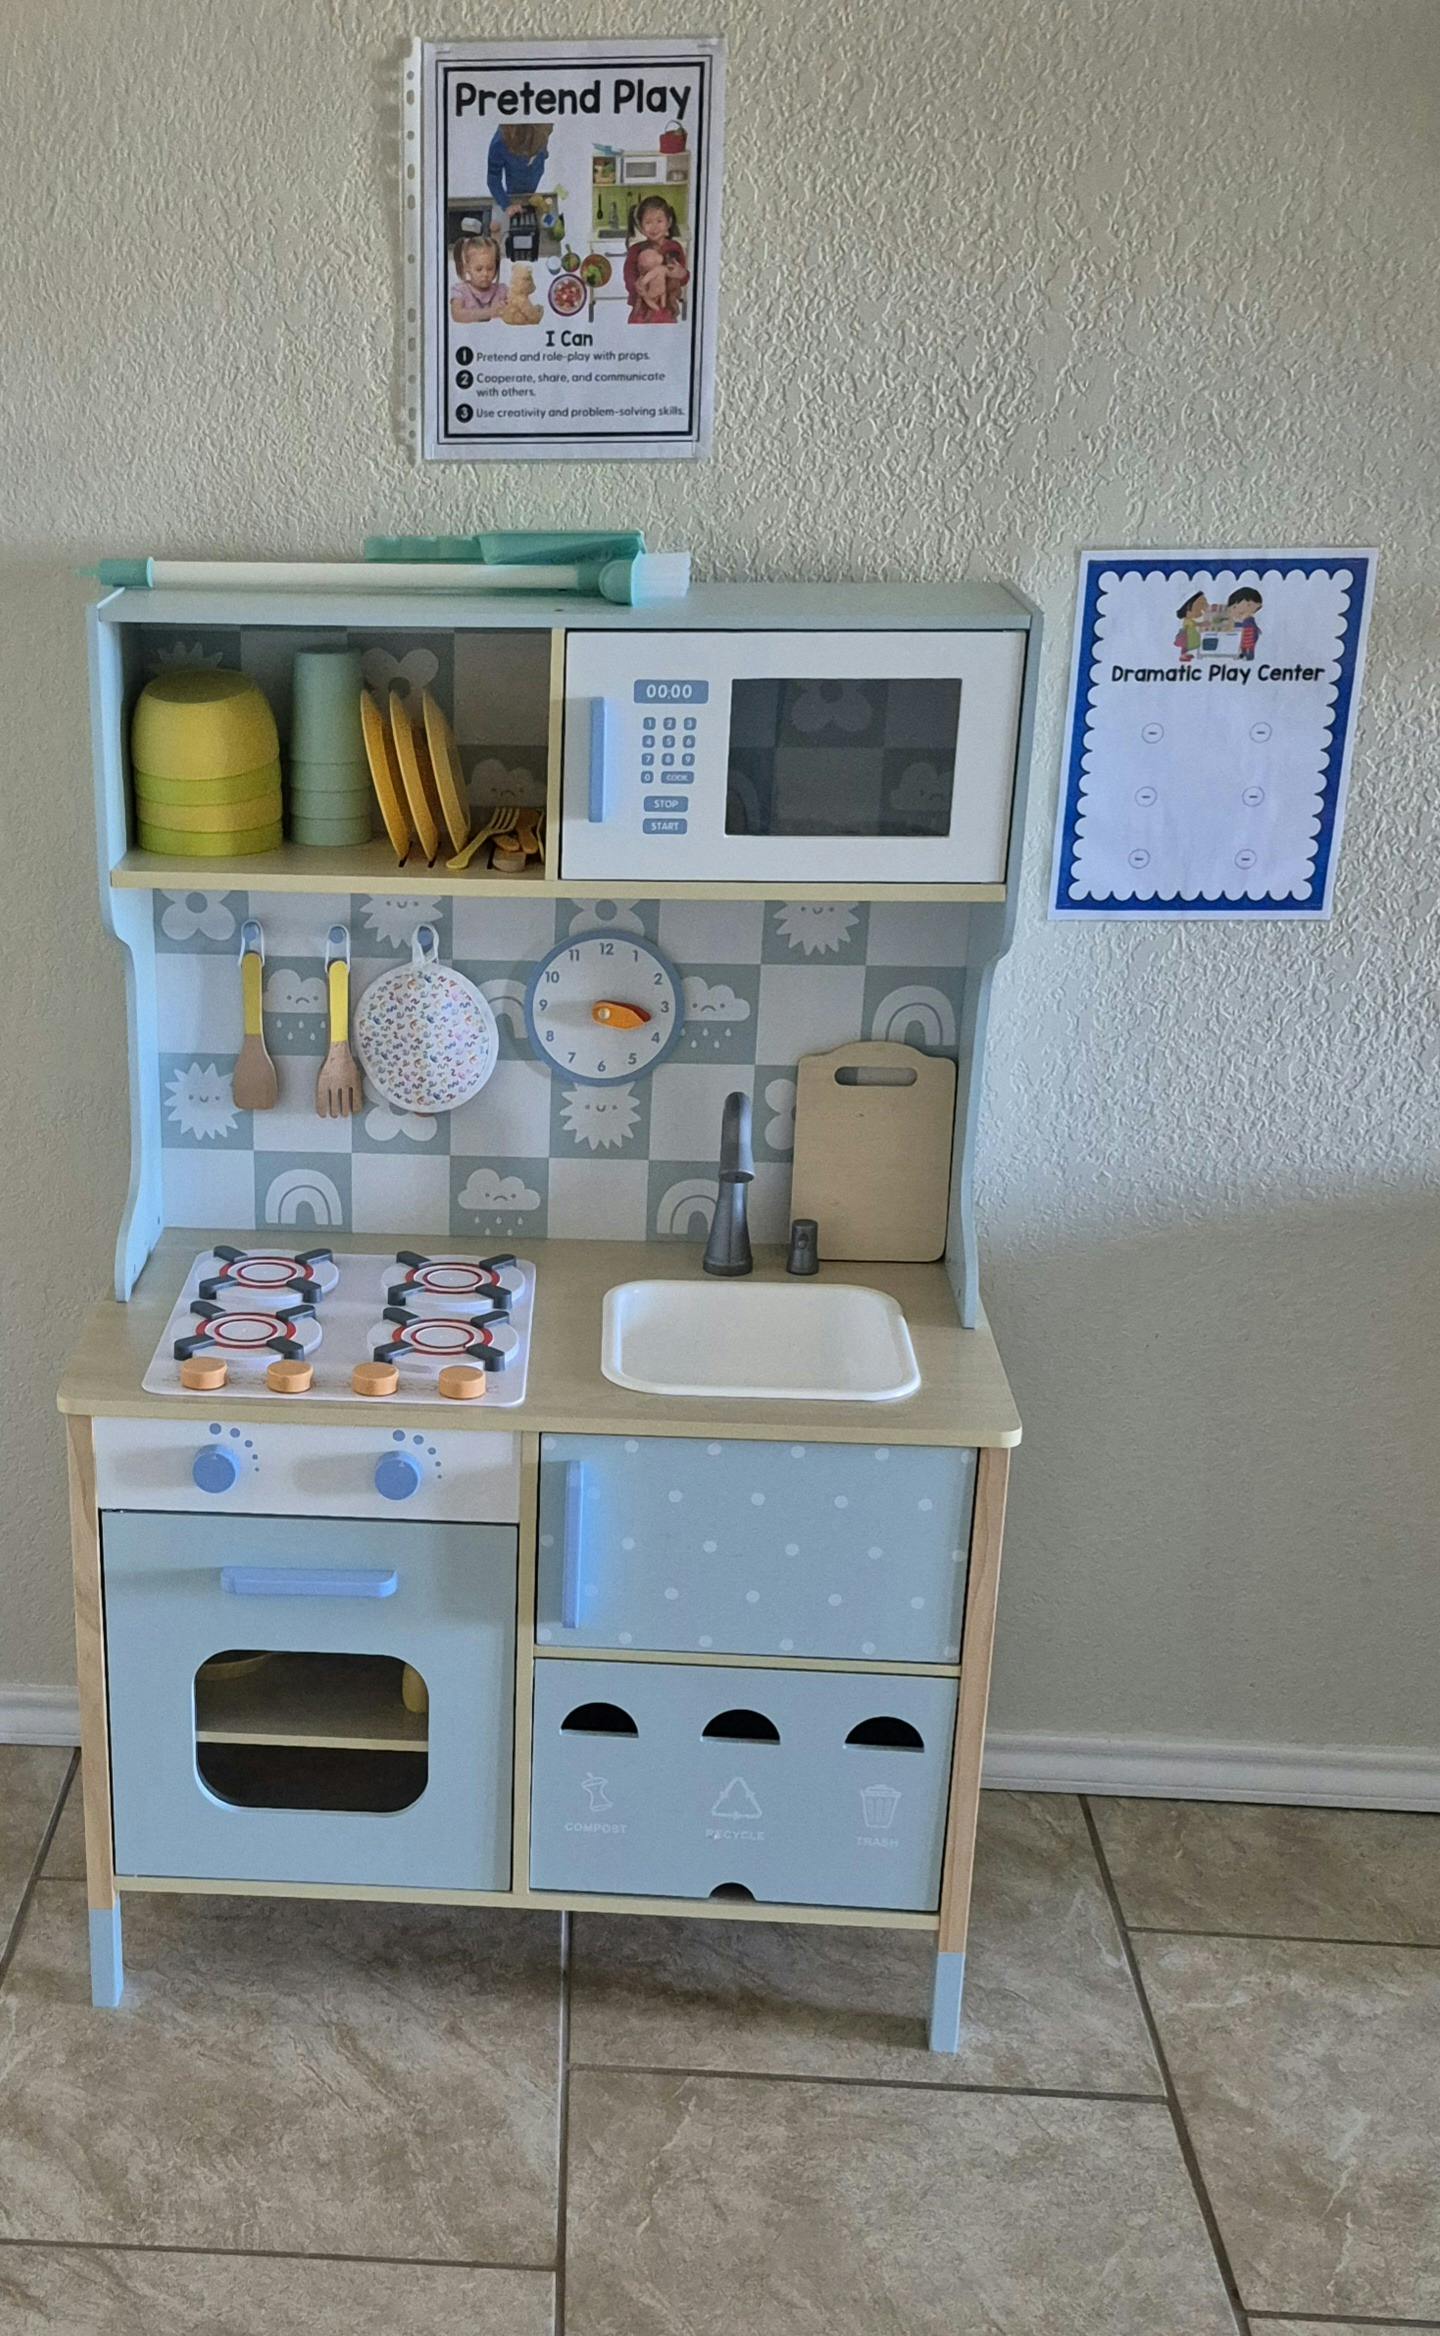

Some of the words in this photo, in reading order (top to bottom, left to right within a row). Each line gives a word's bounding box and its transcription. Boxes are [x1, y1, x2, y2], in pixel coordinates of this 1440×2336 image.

[456, 79, 600, 117] Pretend
[613, 78, 691, 120] Play
[545, 330, 555, 347] I
[560, 330, 593, 347] Can
[476, 352, 518, 362] Pretend
[519, 352, 540, 362] and
[542, 351, 590, 363] role-play
[593, 351, 616, 361] with
[618, 352, 650, 362] props.
[476, 373, 536, 384] Cooperate,
[538, 373, 570, 384] share,
[572, 372, 593, 382] and
[594, 372, 666, 382] communicate
[476, 387, 499, 397] with
[501, 387, 536, 397] others.
[476, 408, 495, 418] Use
[497, 408, 546, 419] creativity
[548, 408, 569, 418] and
[571, 406, 656, 418] problem-solving
[658, 405, 685, 417] skills.
[1111, 665, 1202, 682] Dramatic
[1208, 664, 1251, 685] Play
[1258, 664, 1325, 682] Center
[666, 774, 689, 782] COOK
[654, 800, 679, 809] STOP
[651, 822, 679, 831] START
[568, 949, 580, 961] 11
[600, 942, 614, 956] 12
[633, 950, 639, 961] 1
[545, 971, 560, 983] 10
[654, 973, 663, 985] 2
[539, 999, 548, 1011] 9
[660, 1001, 669, 1013] 3
[546, 1030, 554, 1042] 8
[651, 1032, 660, 1043] 4
[567, 1052, 576, 1063] 7
[627, 1053, 637, 1065] 5
[597, 1060, 606, 1072] 6
[564, 1821, 628, 1834] COMPOST
[705, 1828, 765, 1841] RECYCLE
[855, 1835, 900, 1849] TRASH
